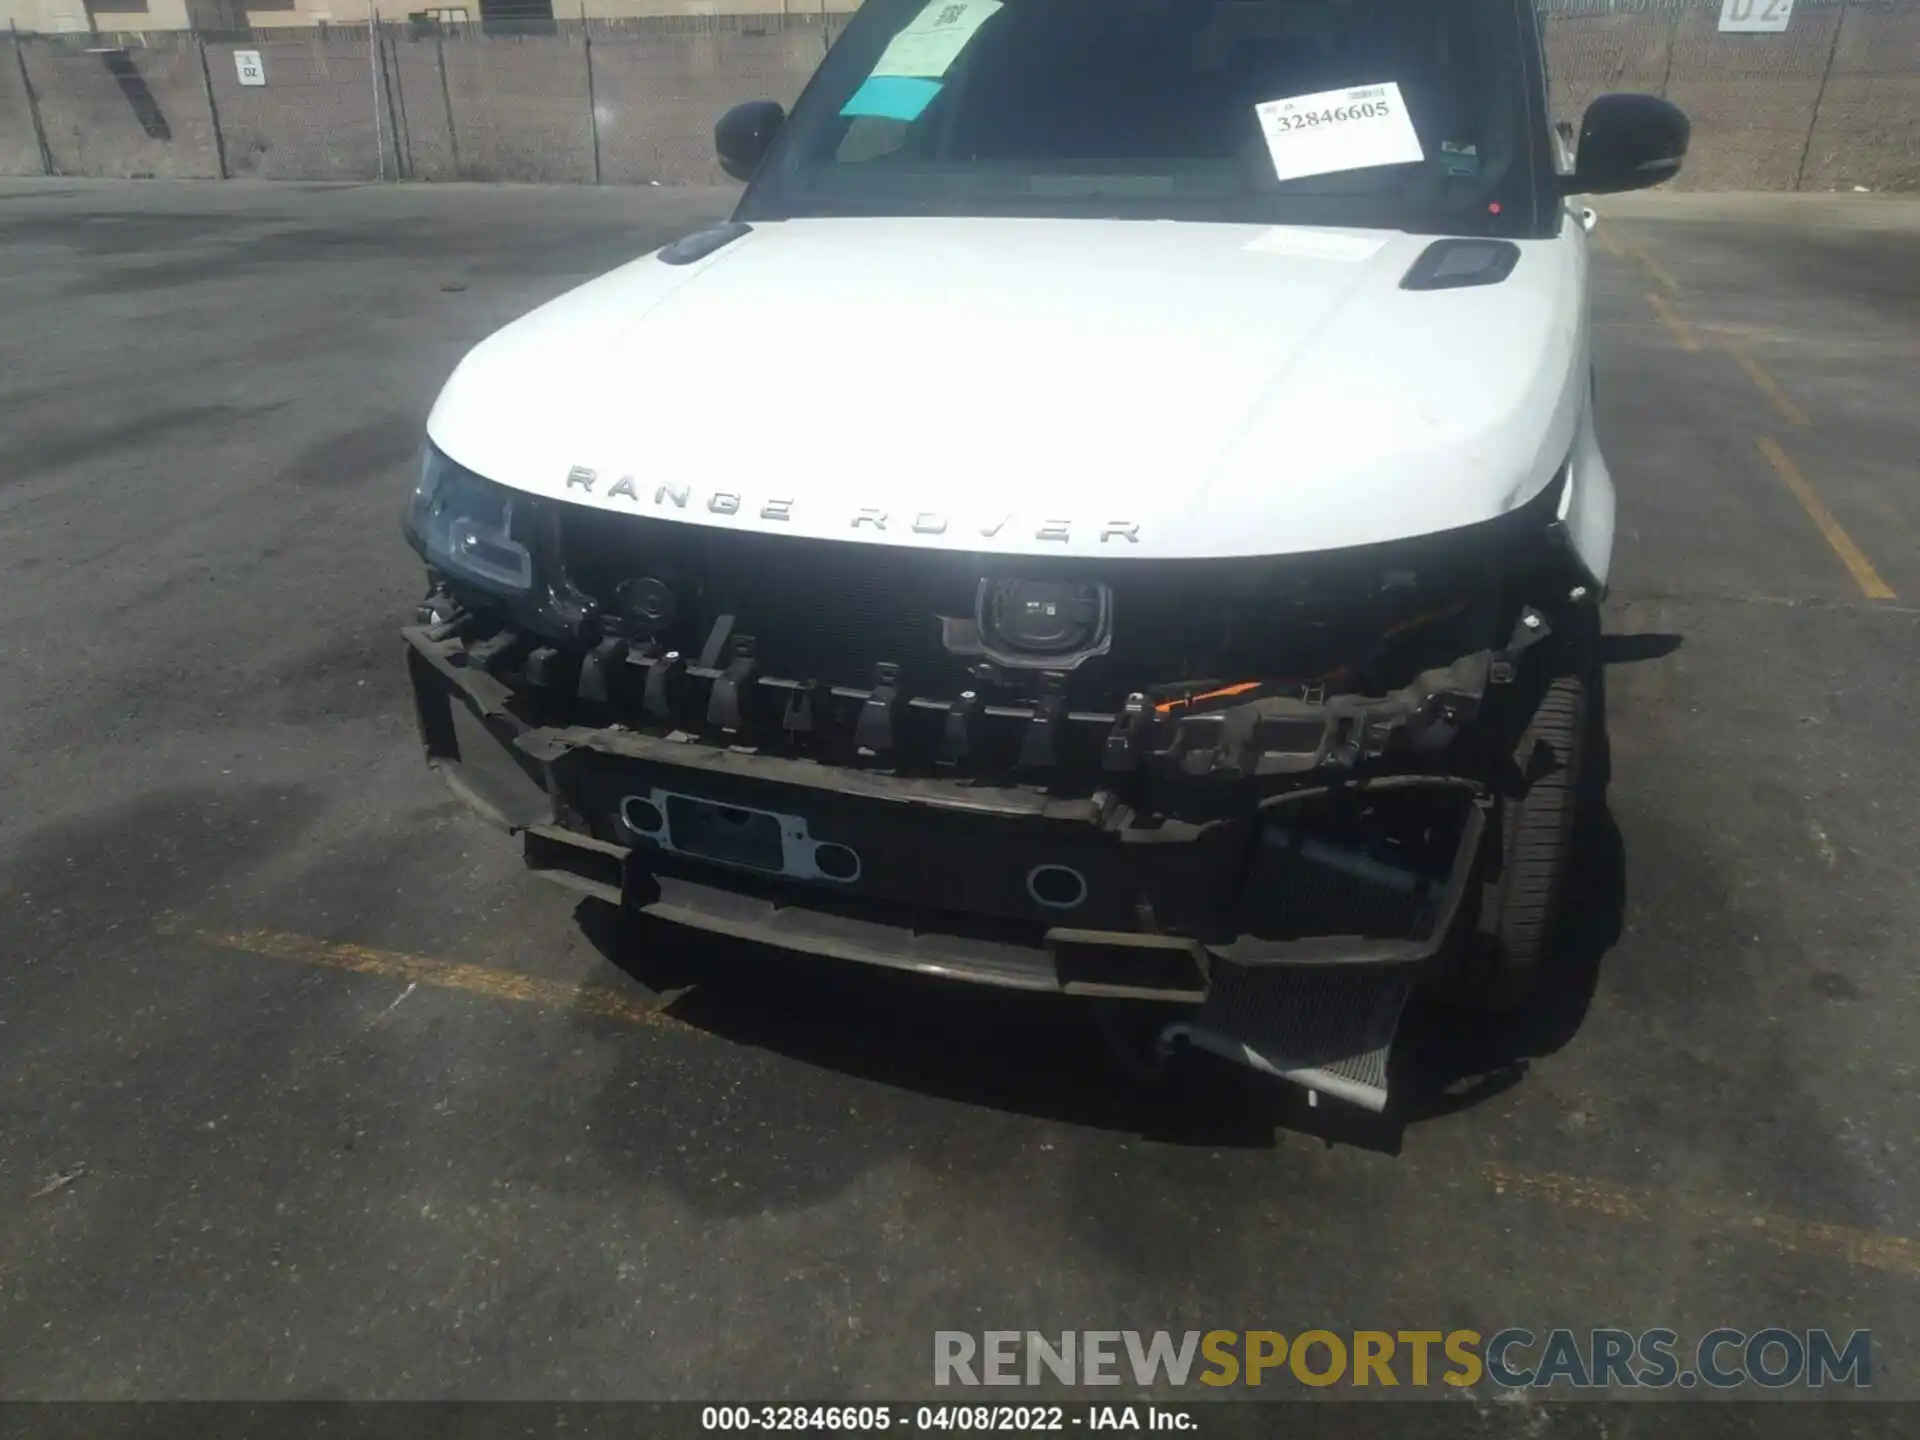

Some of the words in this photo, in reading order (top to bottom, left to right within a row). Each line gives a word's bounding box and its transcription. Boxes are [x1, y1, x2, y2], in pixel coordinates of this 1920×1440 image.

[1277, 100, 1390, 132] 32846605
[565, 464, 795, 522] RANGE
[850, 507, 1141, 544] ROVER
